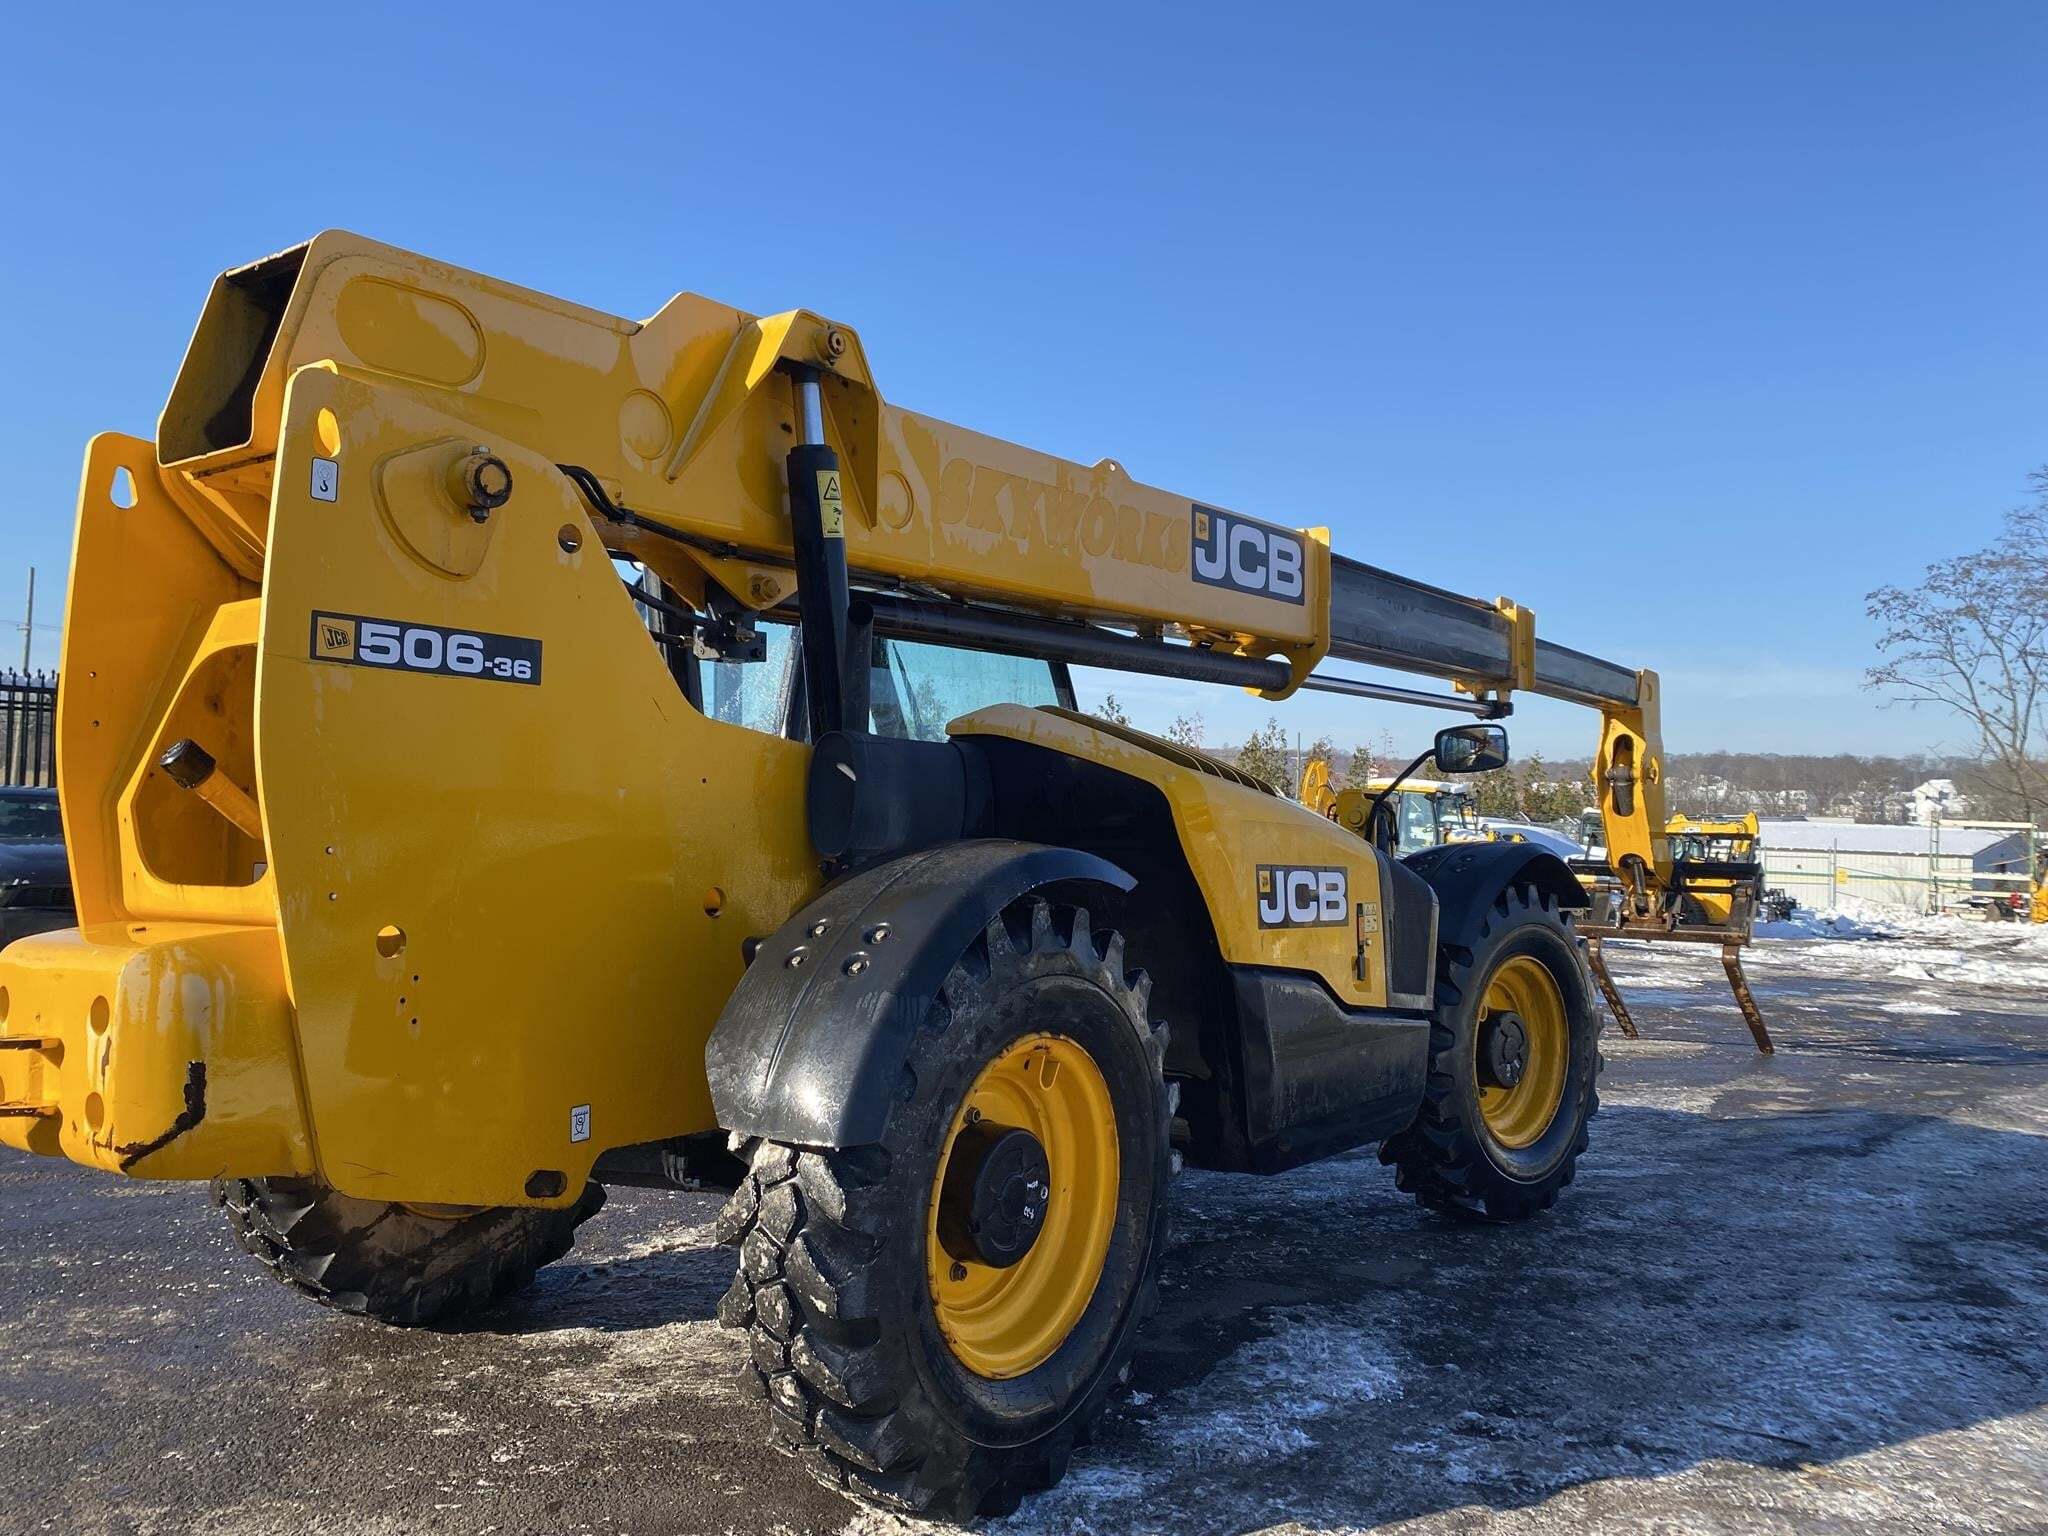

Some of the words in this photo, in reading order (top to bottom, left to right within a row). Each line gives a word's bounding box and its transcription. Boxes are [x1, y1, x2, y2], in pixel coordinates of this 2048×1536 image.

[1195, 517, 1303, 598] JCB
[326, 626, 350, 649] JCB
[359, 622, 532, 679] 506-36
[1260, 870, 1348, 924] JCB
